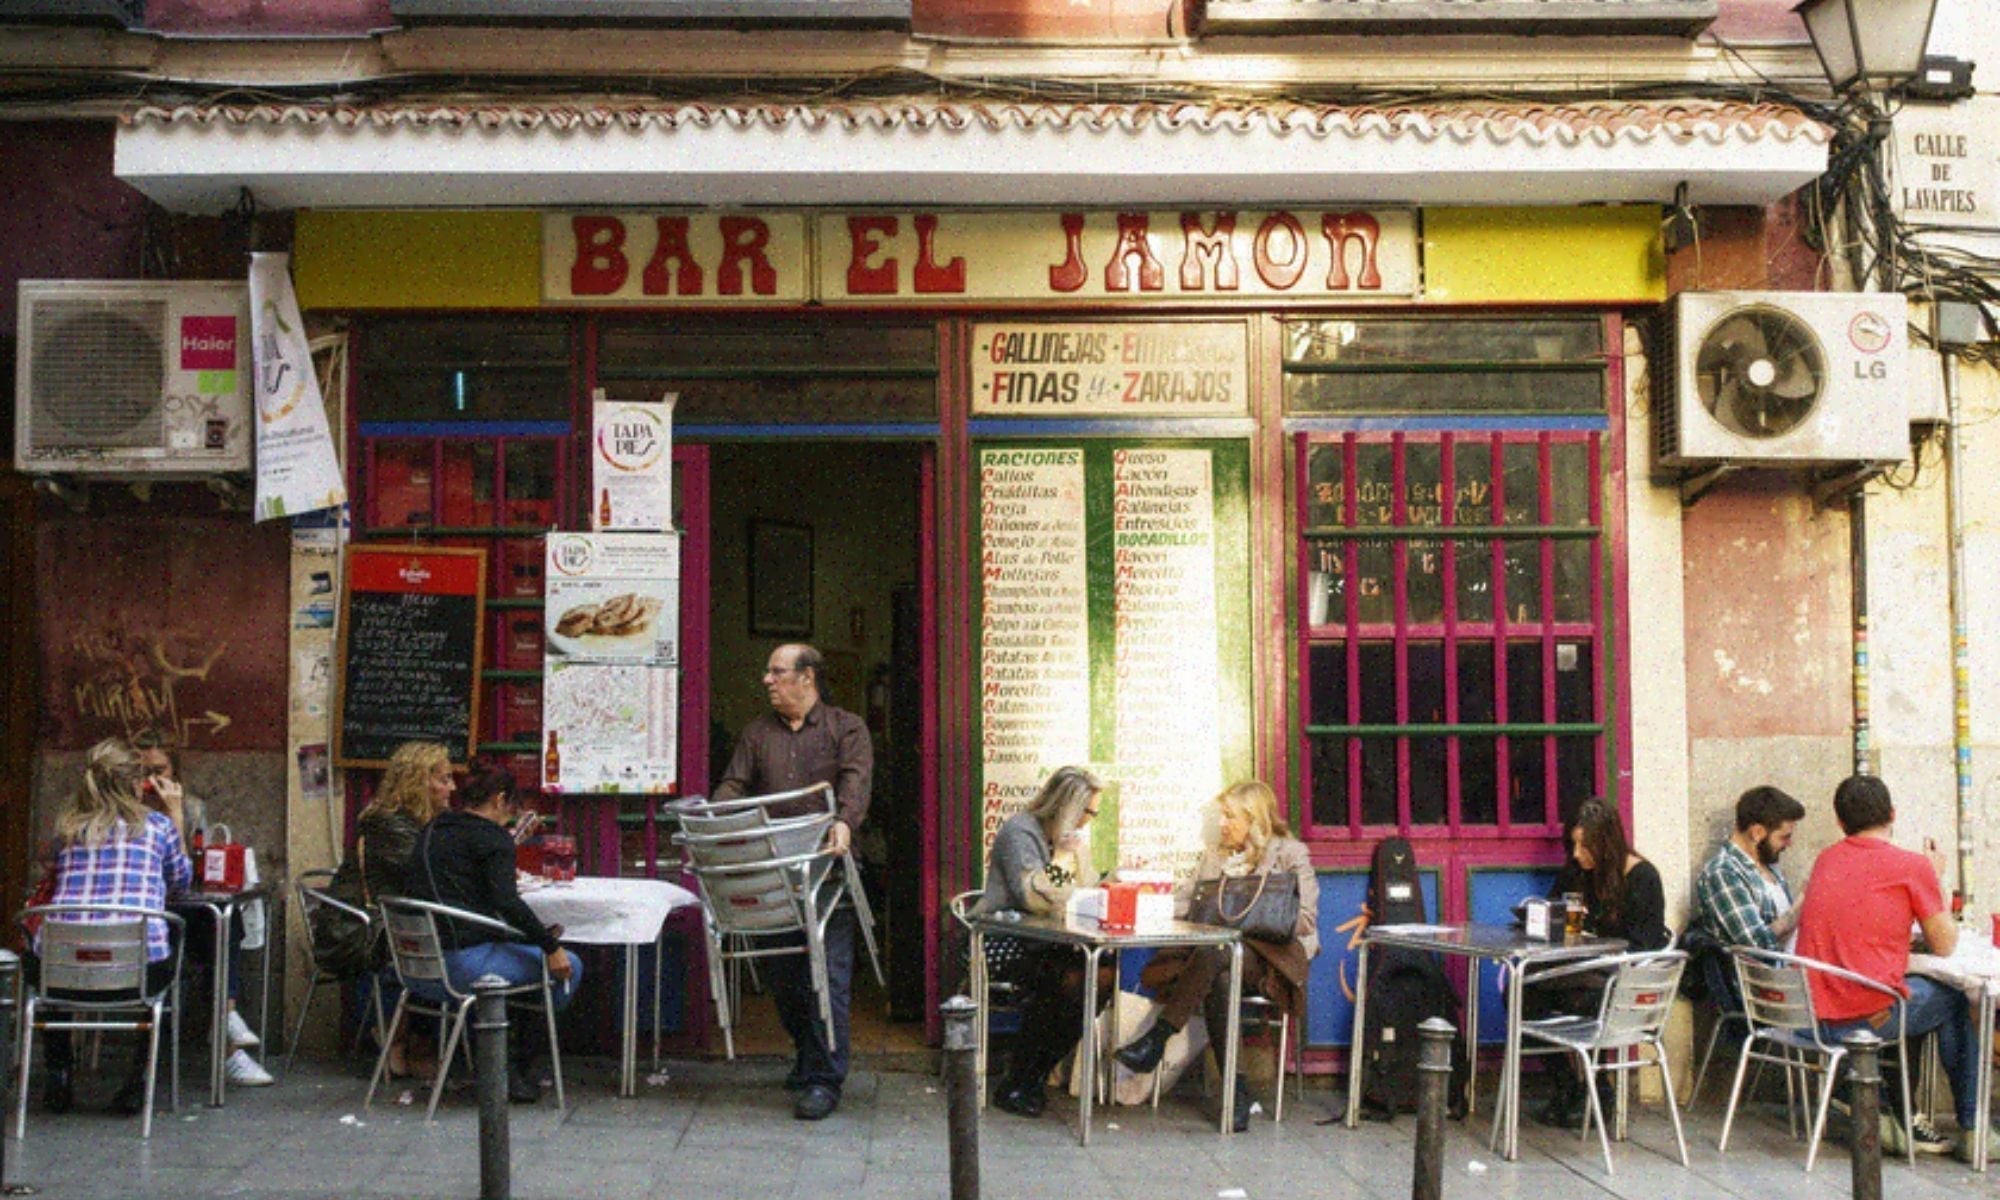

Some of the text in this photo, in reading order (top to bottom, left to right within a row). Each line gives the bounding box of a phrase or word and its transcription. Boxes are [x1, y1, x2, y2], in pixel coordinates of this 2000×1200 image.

[1914, 133, 1967, 157] CALLE
[1931, 163, 1951, 181] DE
[1903, 187, 1976, 213] LAVAPIES
[570, 214, 777, 296] BAR
[846, 213, 967, 295] EL
[183, 336, 234, 351] Haier
[991, 332, 1107, 364] GALLINEJAS
[1854, 360, 1887, 379] LG
[992, 371, 1080, 404] FINAS
[1122, 371, 1232, 404] ZARAJOS
[612, 423, 653, 438] TAPA
[984, 451, 1079, 467] RACIONES
